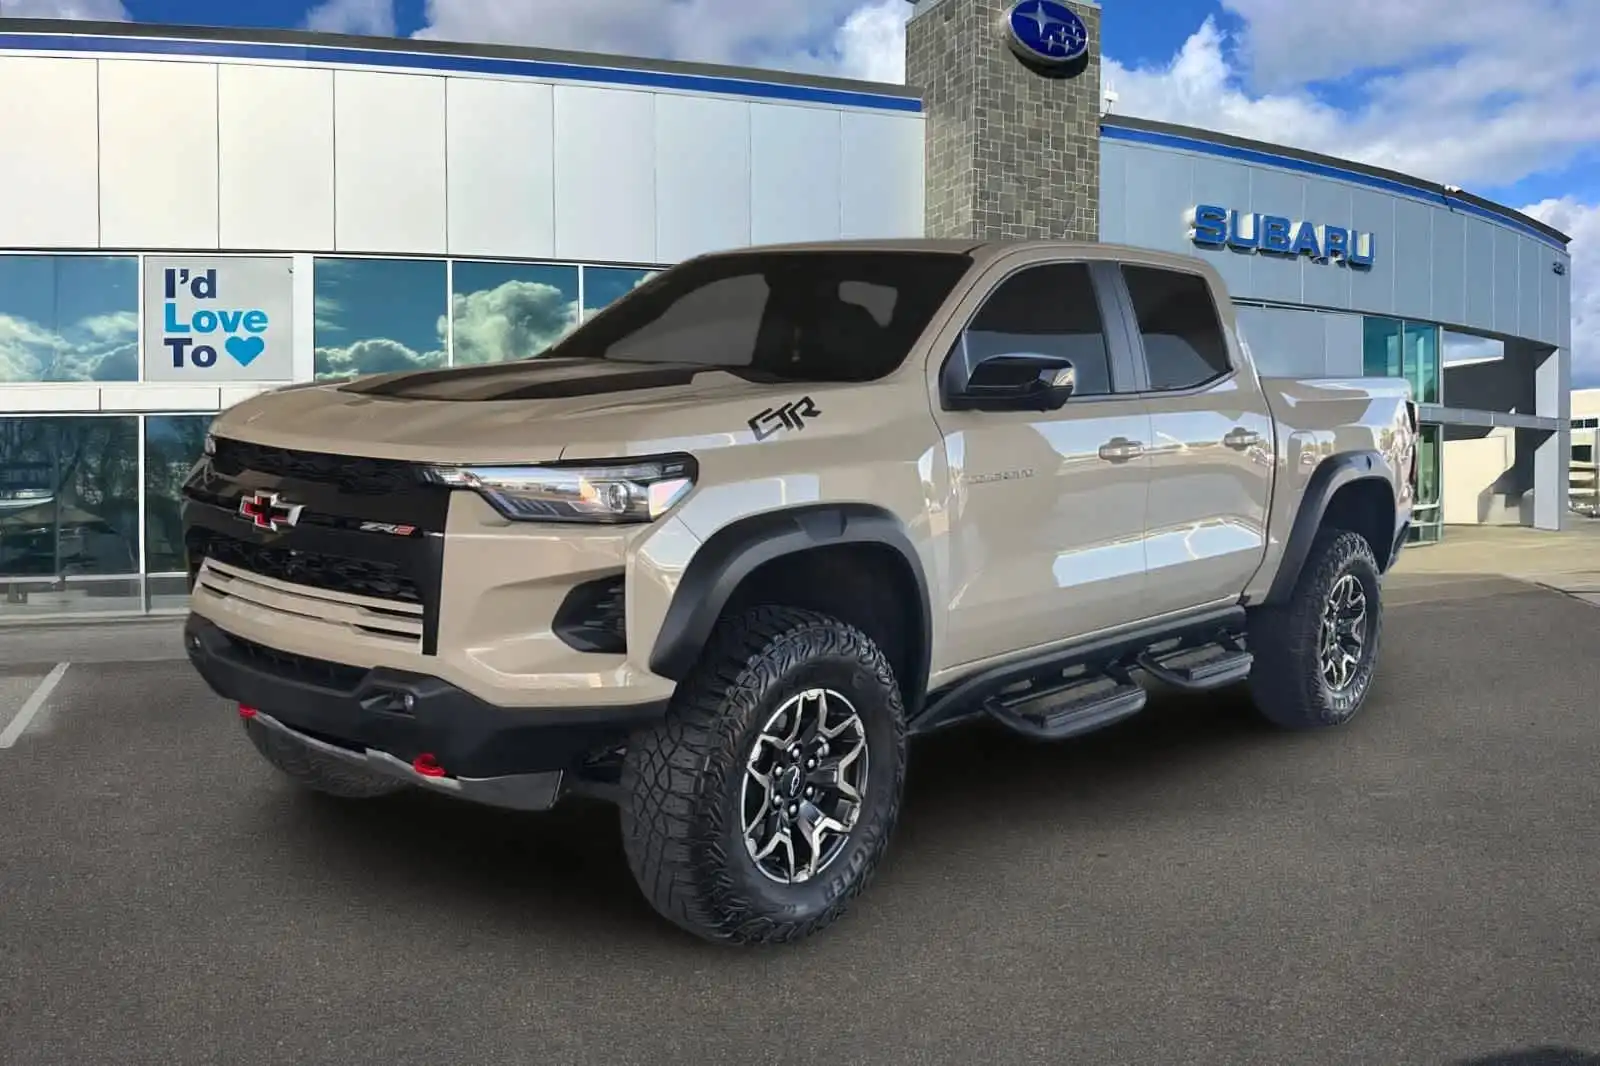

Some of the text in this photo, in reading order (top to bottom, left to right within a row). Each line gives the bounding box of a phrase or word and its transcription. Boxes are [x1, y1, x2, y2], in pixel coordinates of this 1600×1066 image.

[1193, 204, 1376, 267] SUBARU
[164, 268, 217, 299] I'd
[164, 302, 269, 333] Love
[163, 337, 218, 368] To
